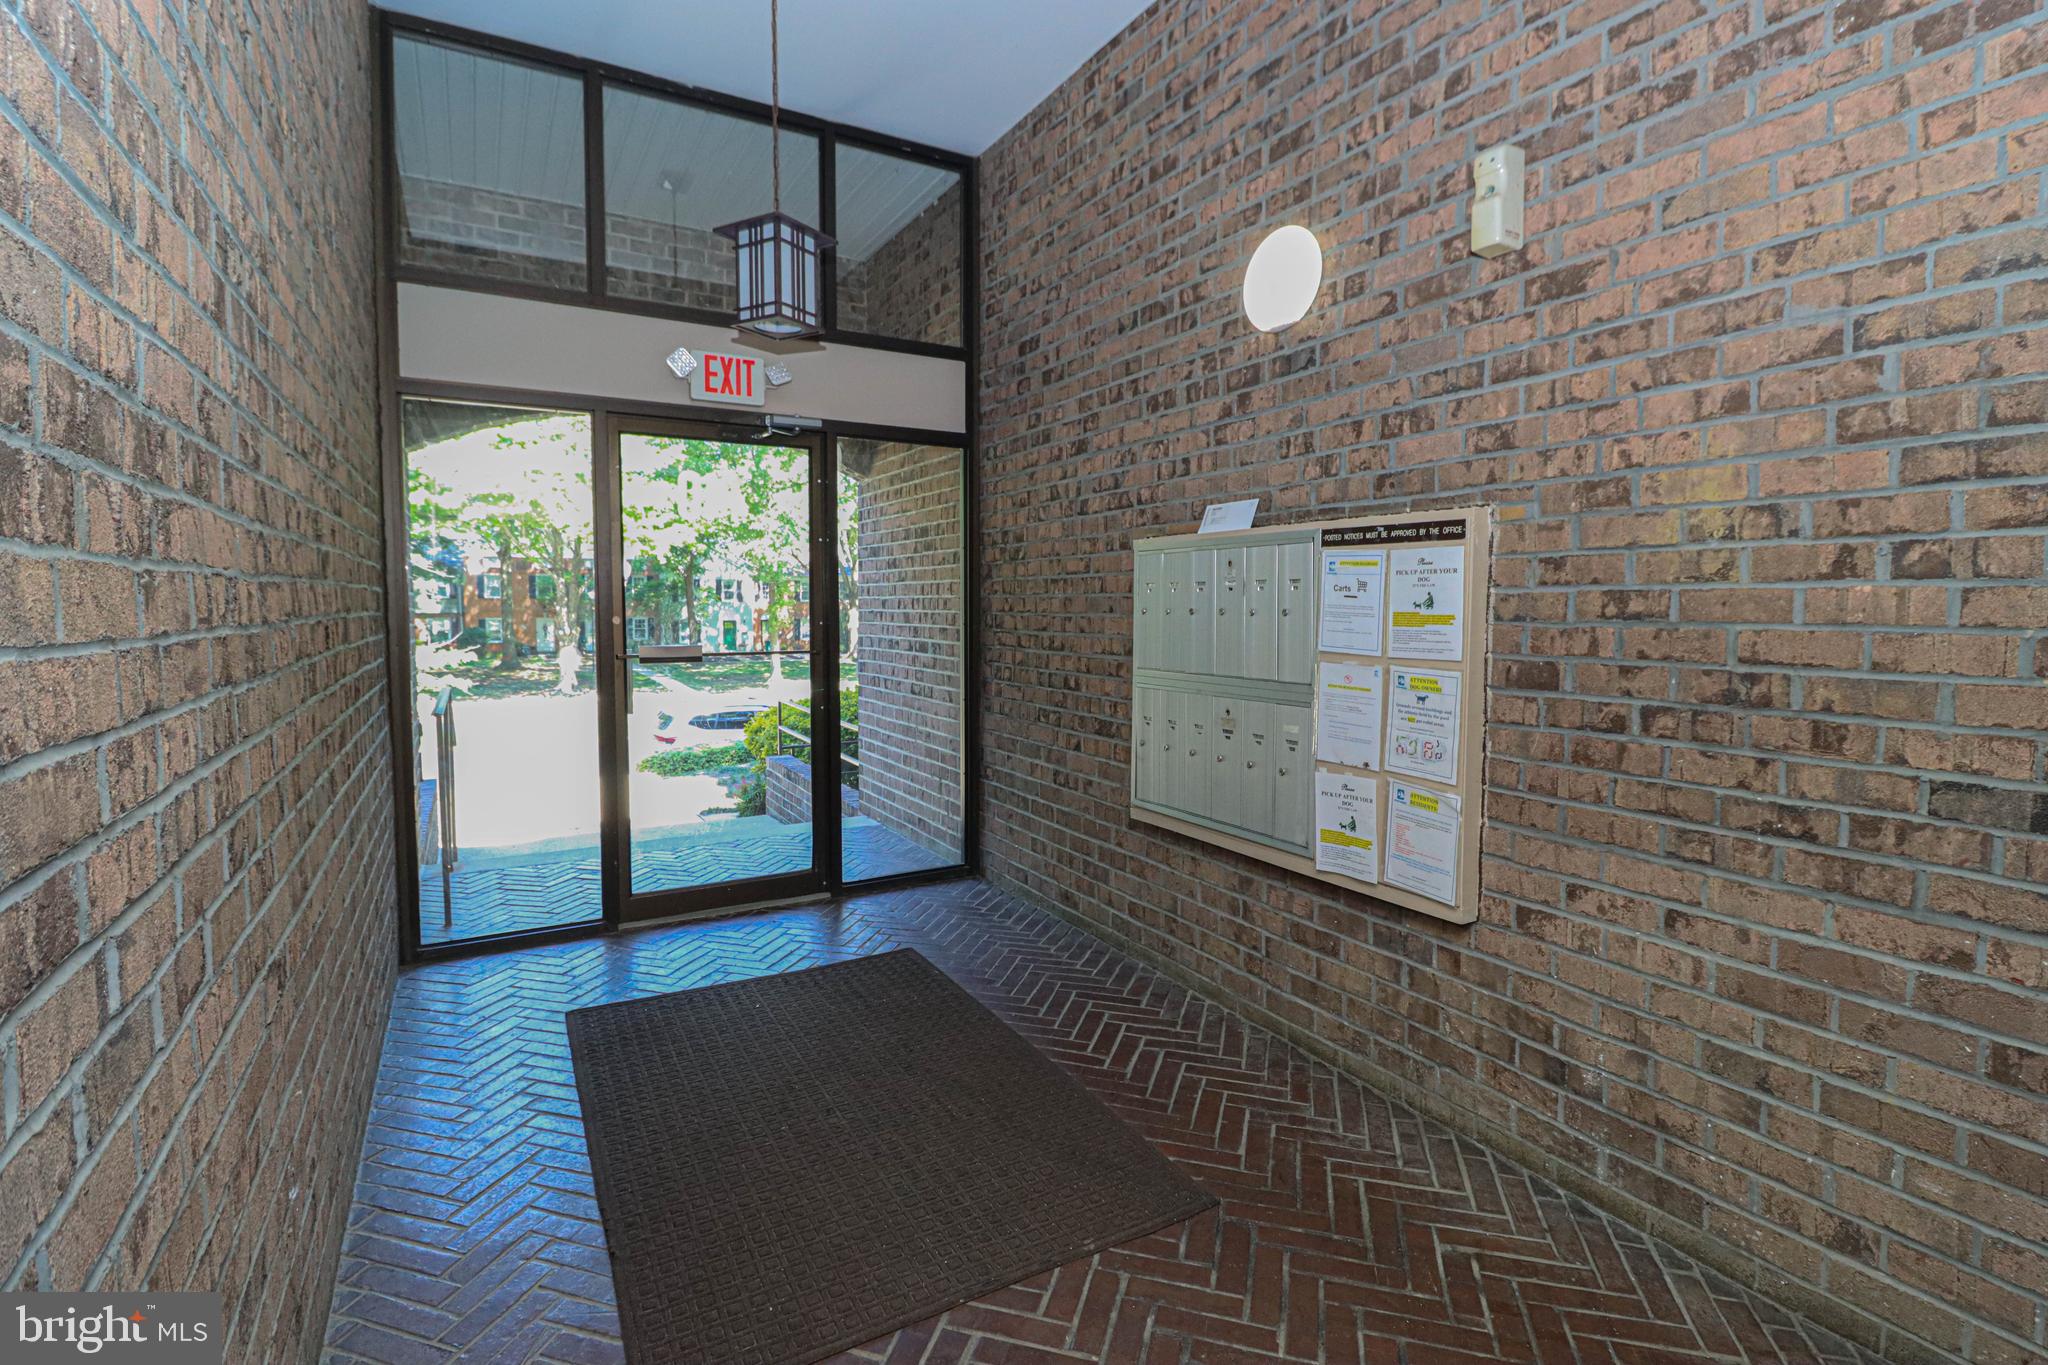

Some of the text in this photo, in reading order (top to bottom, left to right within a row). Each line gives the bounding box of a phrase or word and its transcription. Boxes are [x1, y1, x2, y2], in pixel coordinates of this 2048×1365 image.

[704, 354, 755, 397] EXIT
[1324, 533, 1342, 541] POSTED
[1344, 532, 1363, 540] NOTICES
[1366, 531, 1379, 539] MUST
[1380, 530, 1388, 538] BE
[1391, 528, 1417, 537] APPROVED
[1419, 528, 1426, 536] BY
[1429, 527, 1439, 535] THE
[1442, 526, 1463, 534] OFFICE
[1333, 584, 1351, 592] Carts
